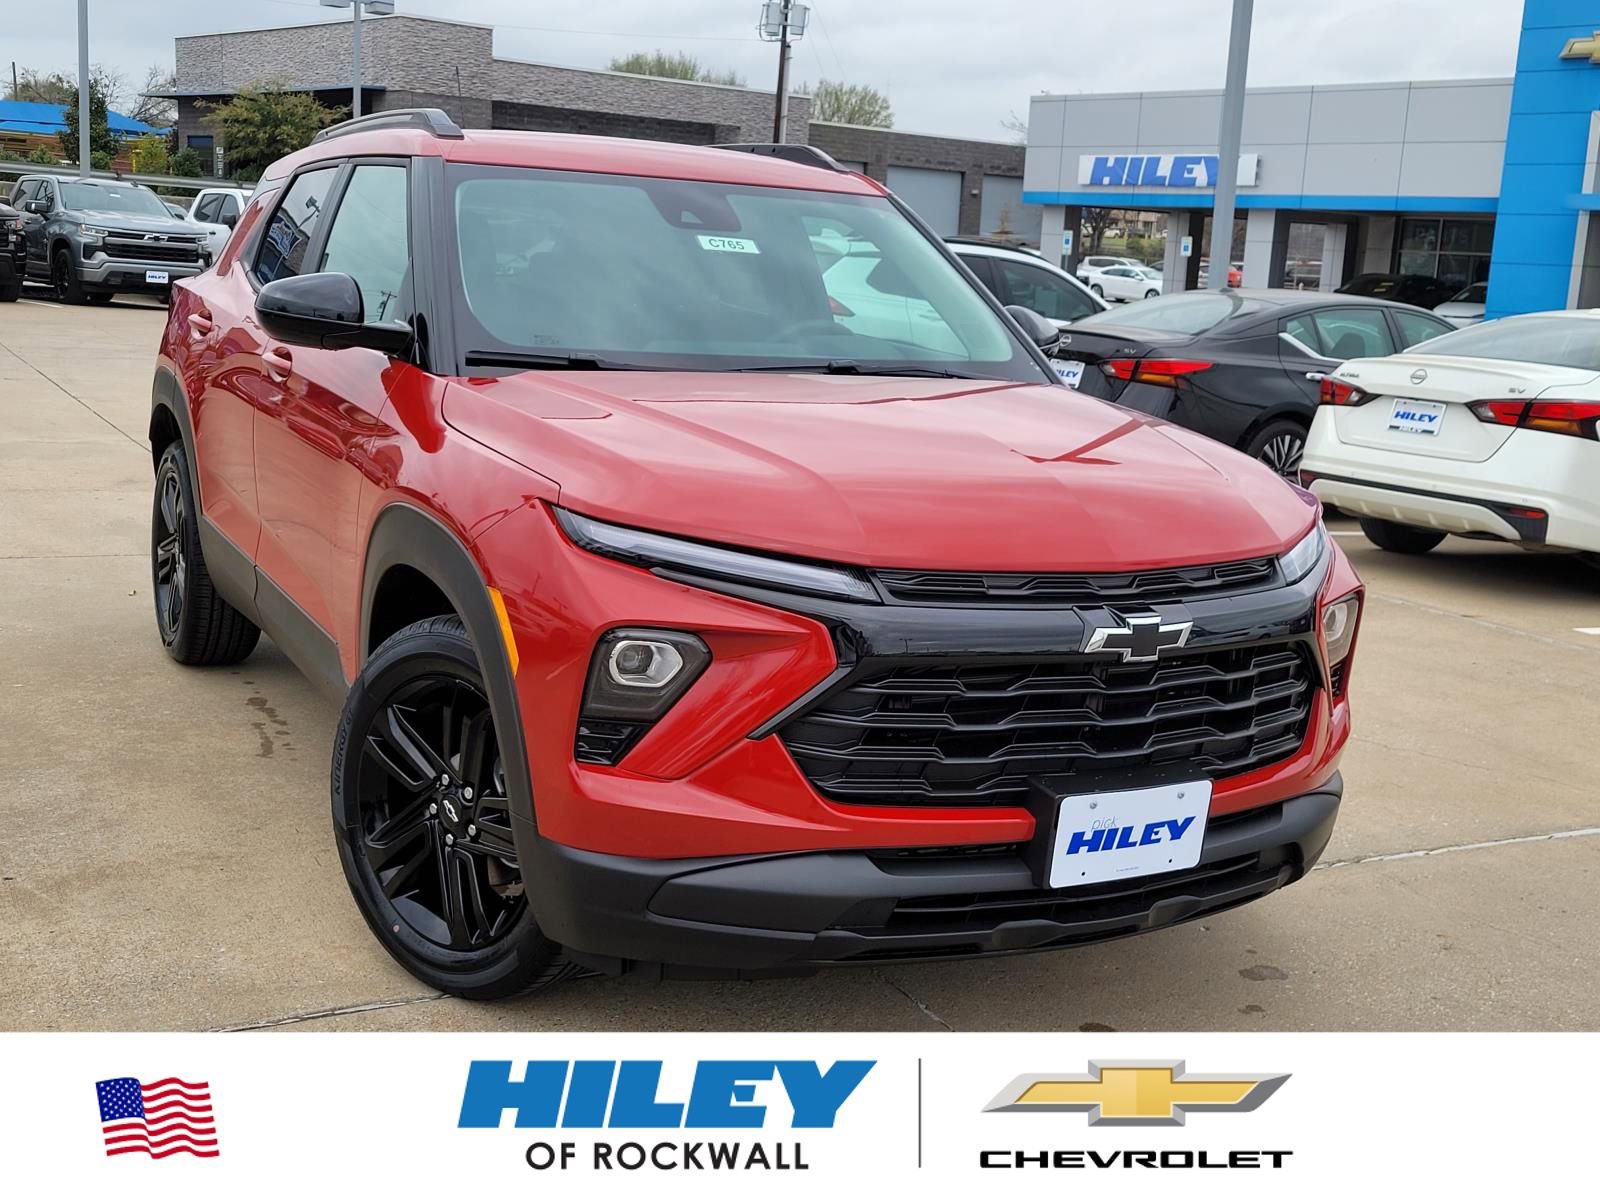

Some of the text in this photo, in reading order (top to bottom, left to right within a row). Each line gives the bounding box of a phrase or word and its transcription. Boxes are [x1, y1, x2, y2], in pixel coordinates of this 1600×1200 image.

[708, 238, 745, 250] C765
[1056, 369, 1079, 378] ILEY
[1394, 411, 1438, 423] HILEY
[1066, 816, 1196, 855] HILEY
